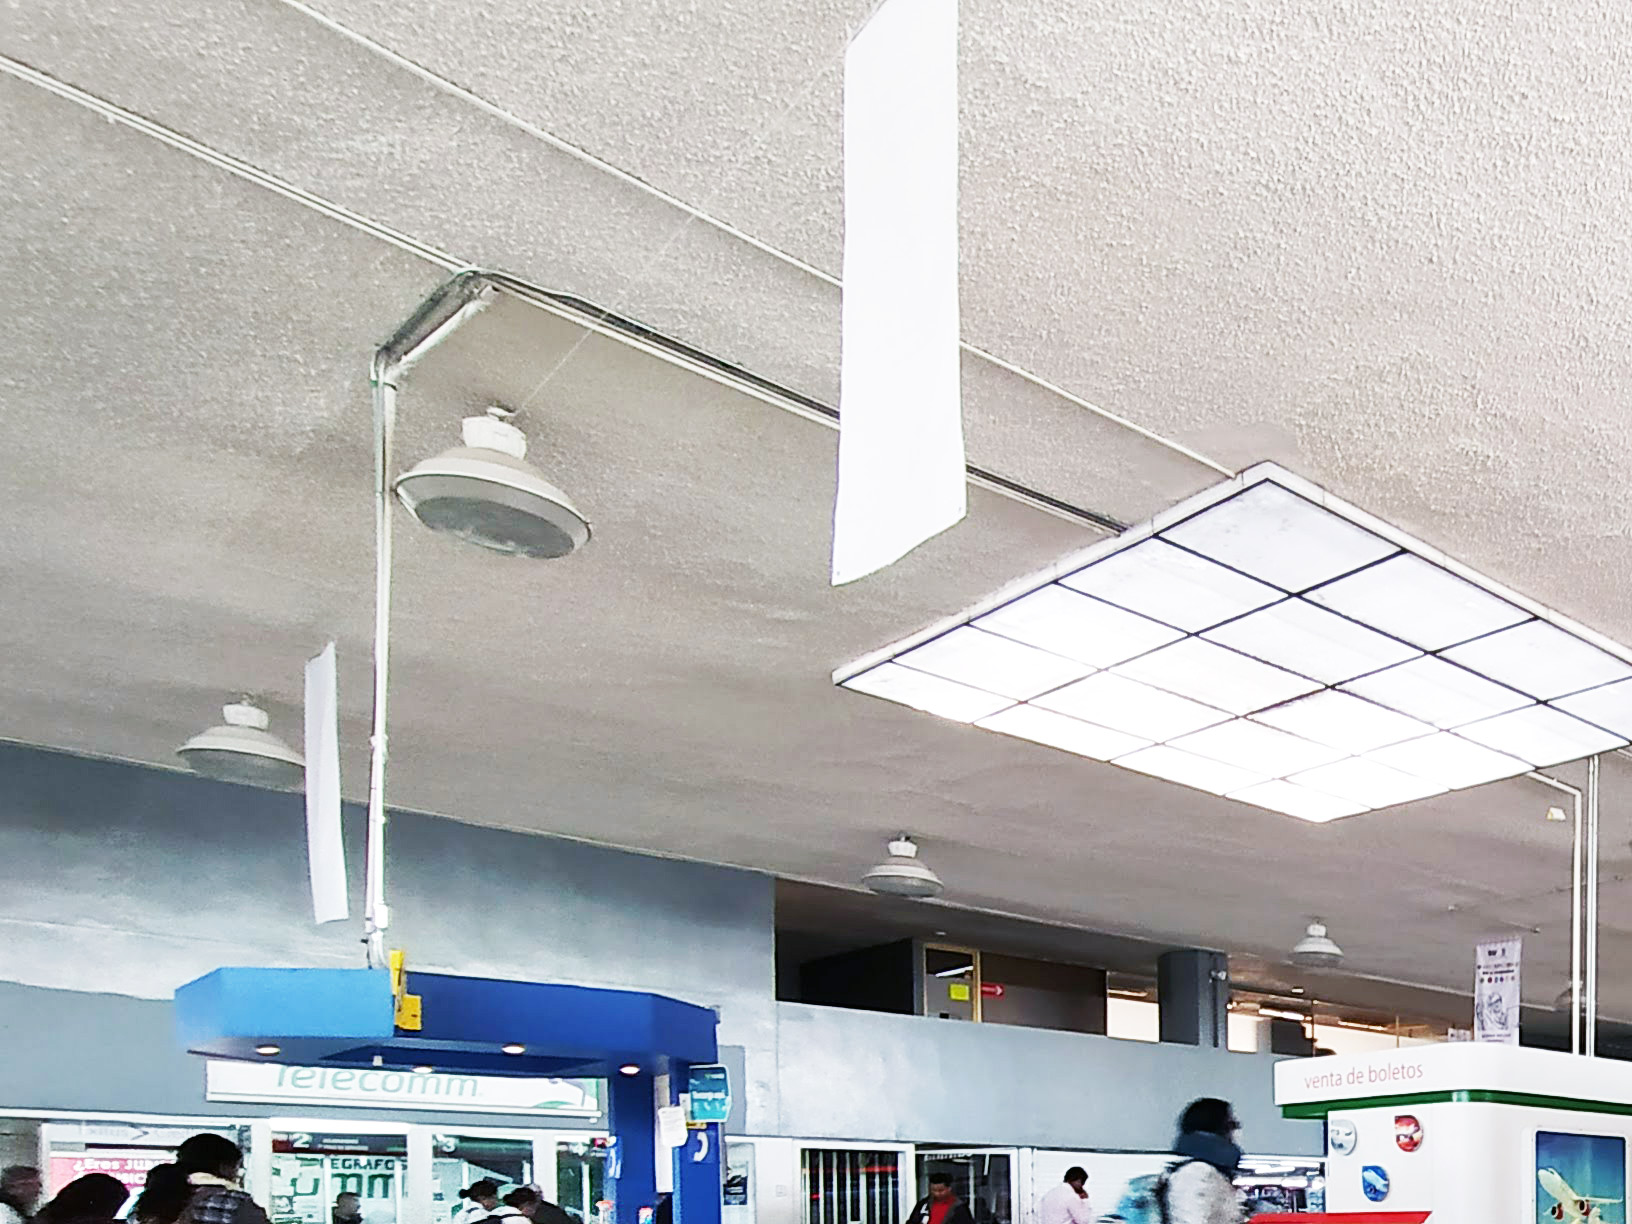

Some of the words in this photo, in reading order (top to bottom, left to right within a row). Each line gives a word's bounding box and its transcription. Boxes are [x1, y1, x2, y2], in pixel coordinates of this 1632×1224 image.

[1304, 1072, 1342, 1089] venta
[1346, 1067, 1364, 1085] de
[1368, 1062, 1424, 1083] boletos
[292, 1133, 312, 1148] 2
